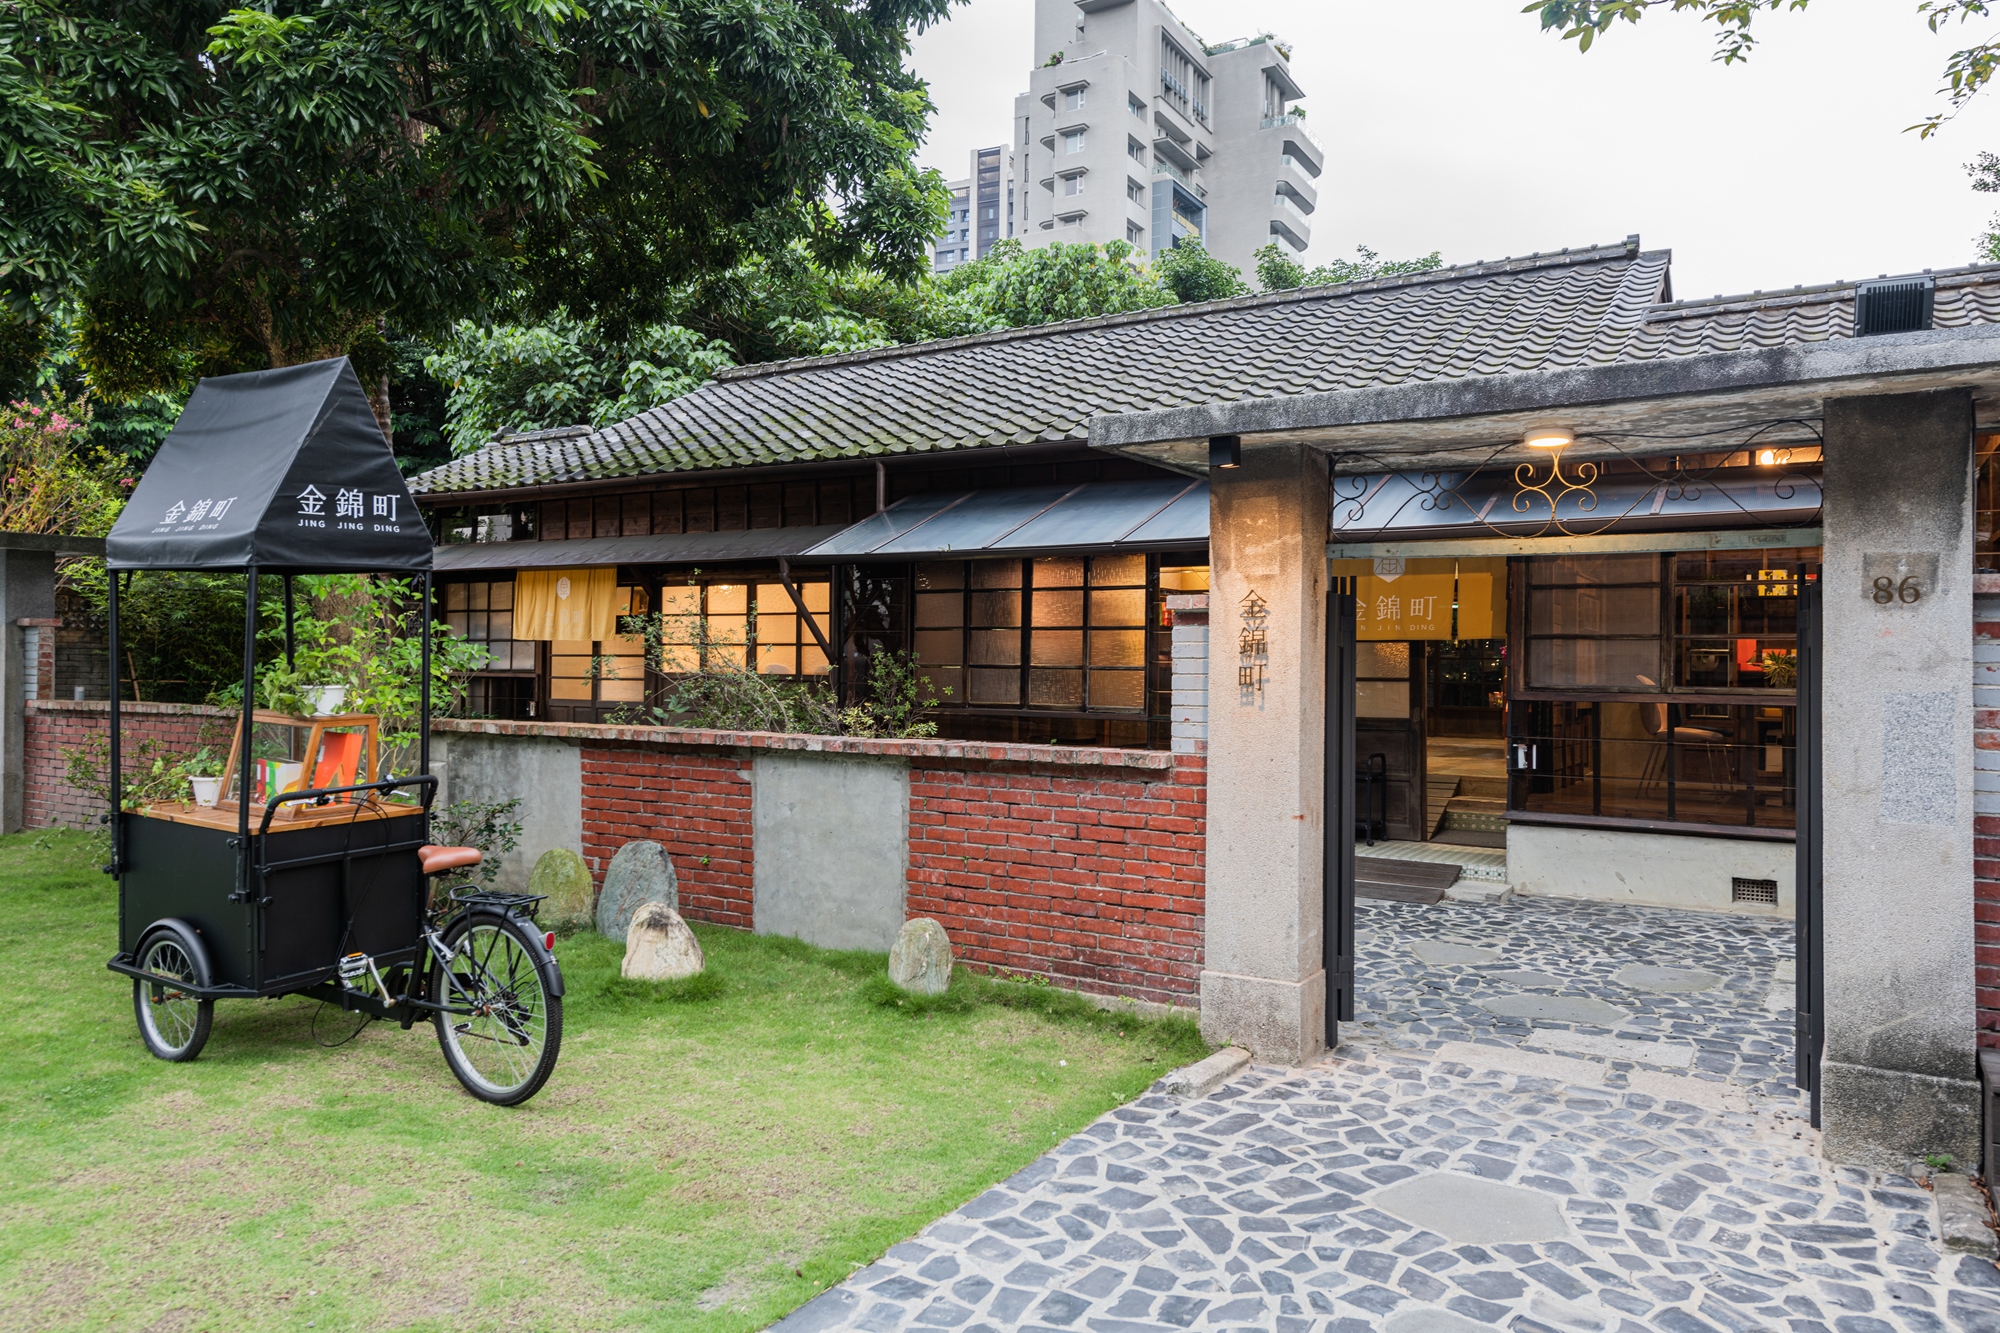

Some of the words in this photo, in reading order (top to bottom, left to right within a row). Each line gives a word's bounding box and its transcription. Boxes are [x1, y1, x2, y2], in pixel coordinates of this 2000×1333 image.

[159, 496, 238, 524] 金錦町
[296, 484, 401, 522] 金錦町
[198, 523, 219, 531] DING
[298, 519, 326, 528] JING
[337, 522, 364, 531] JING
[373, 524, 401, 533] DING
[1872, 575, 1921, 605] 86
[1238, 590, 1267, 692] 金錦町
